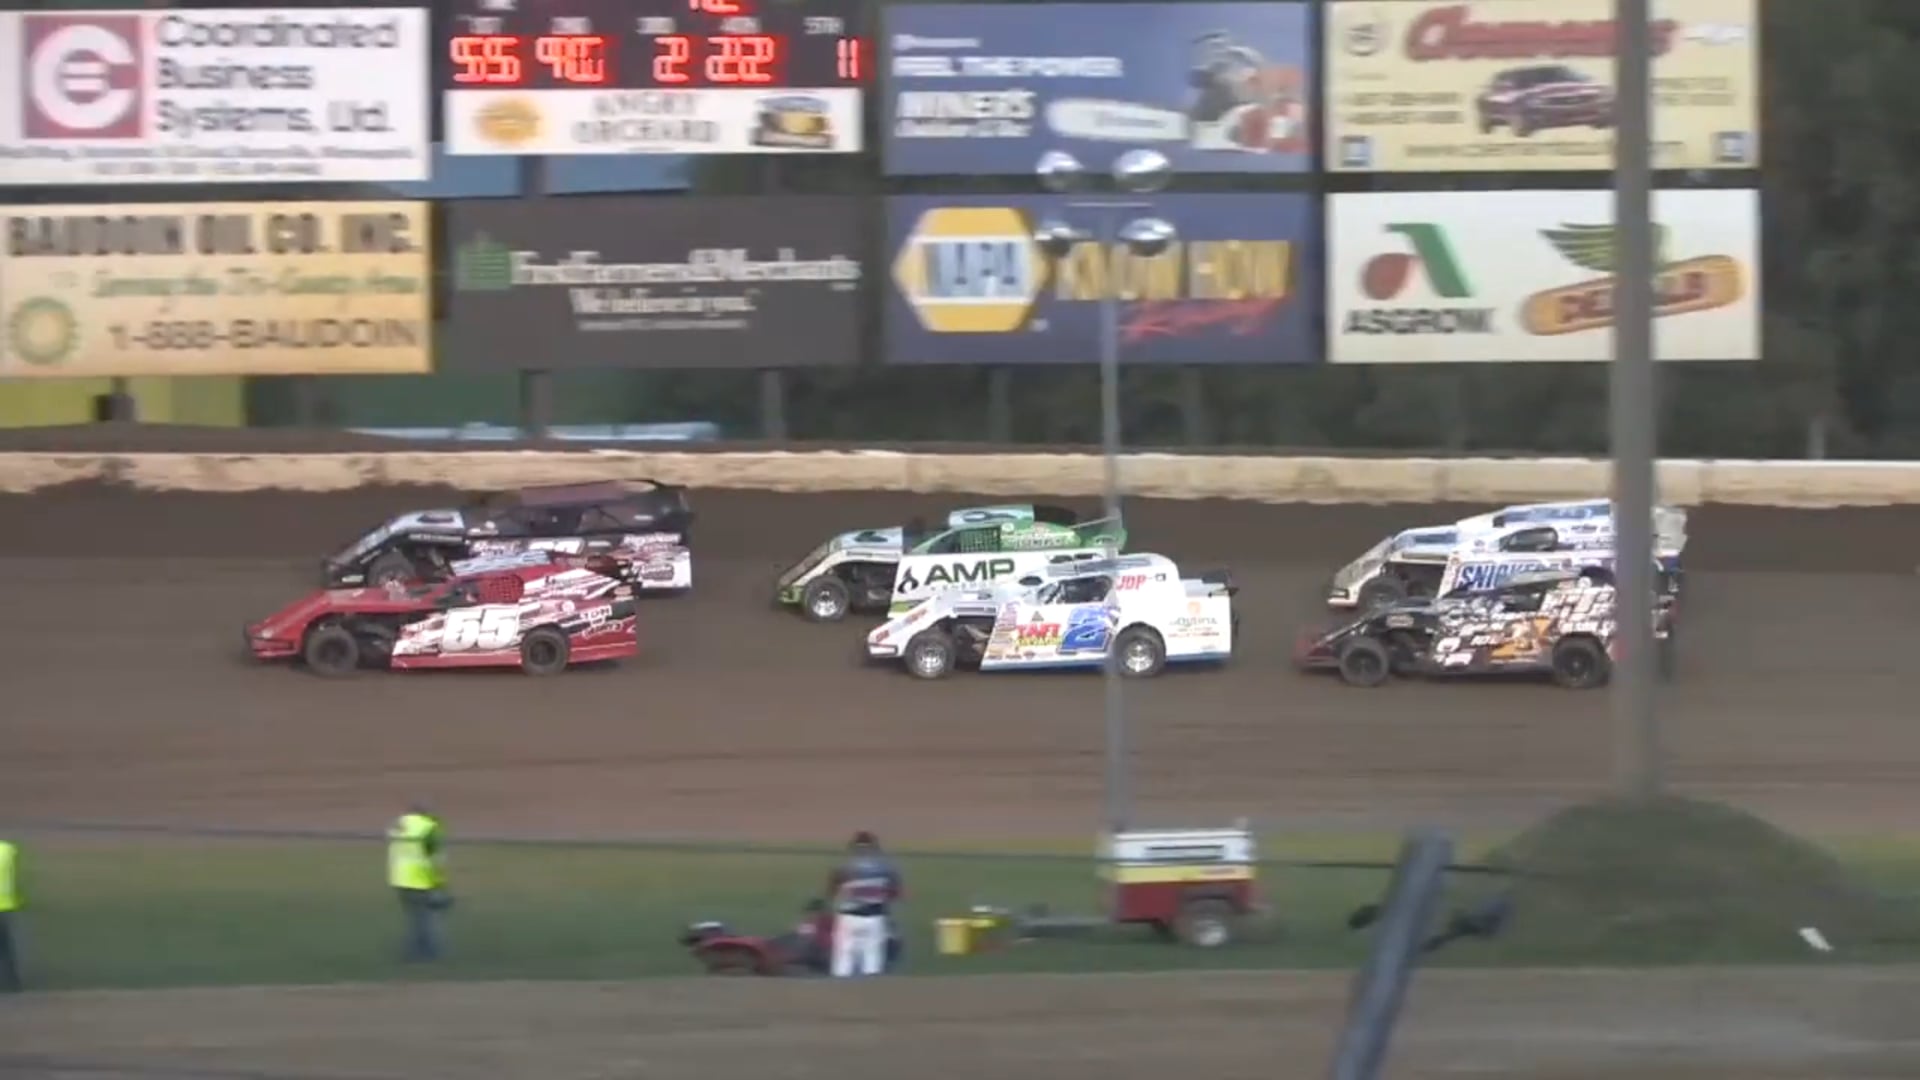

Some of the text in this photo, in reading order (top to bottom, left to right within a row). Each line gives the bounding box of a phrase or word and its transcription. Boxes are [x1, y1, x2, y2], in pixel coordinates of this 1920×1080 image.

[158, 15, 401, 48] Coordinated
[157, 58, 316, 90] Business
[653, 36, 689, 82] 2
[157, 99, 398, 137] Systems, Ltd.
[592, 92, 698, 116] ANGRY
[571, 119, 720, 144] ORCHARD
[8, 212, 422, 257] BAUDOIN OIL CO. INC.
[926, 242, 1031, 298] NAPA
[1187, 239, 1293, 300] HOW
[109, 320, 420, 350] 1-888-BAUDOIN
[1343, 308, 1493, 335] ASGROW
[924, 559, 1015, 586] AMP
